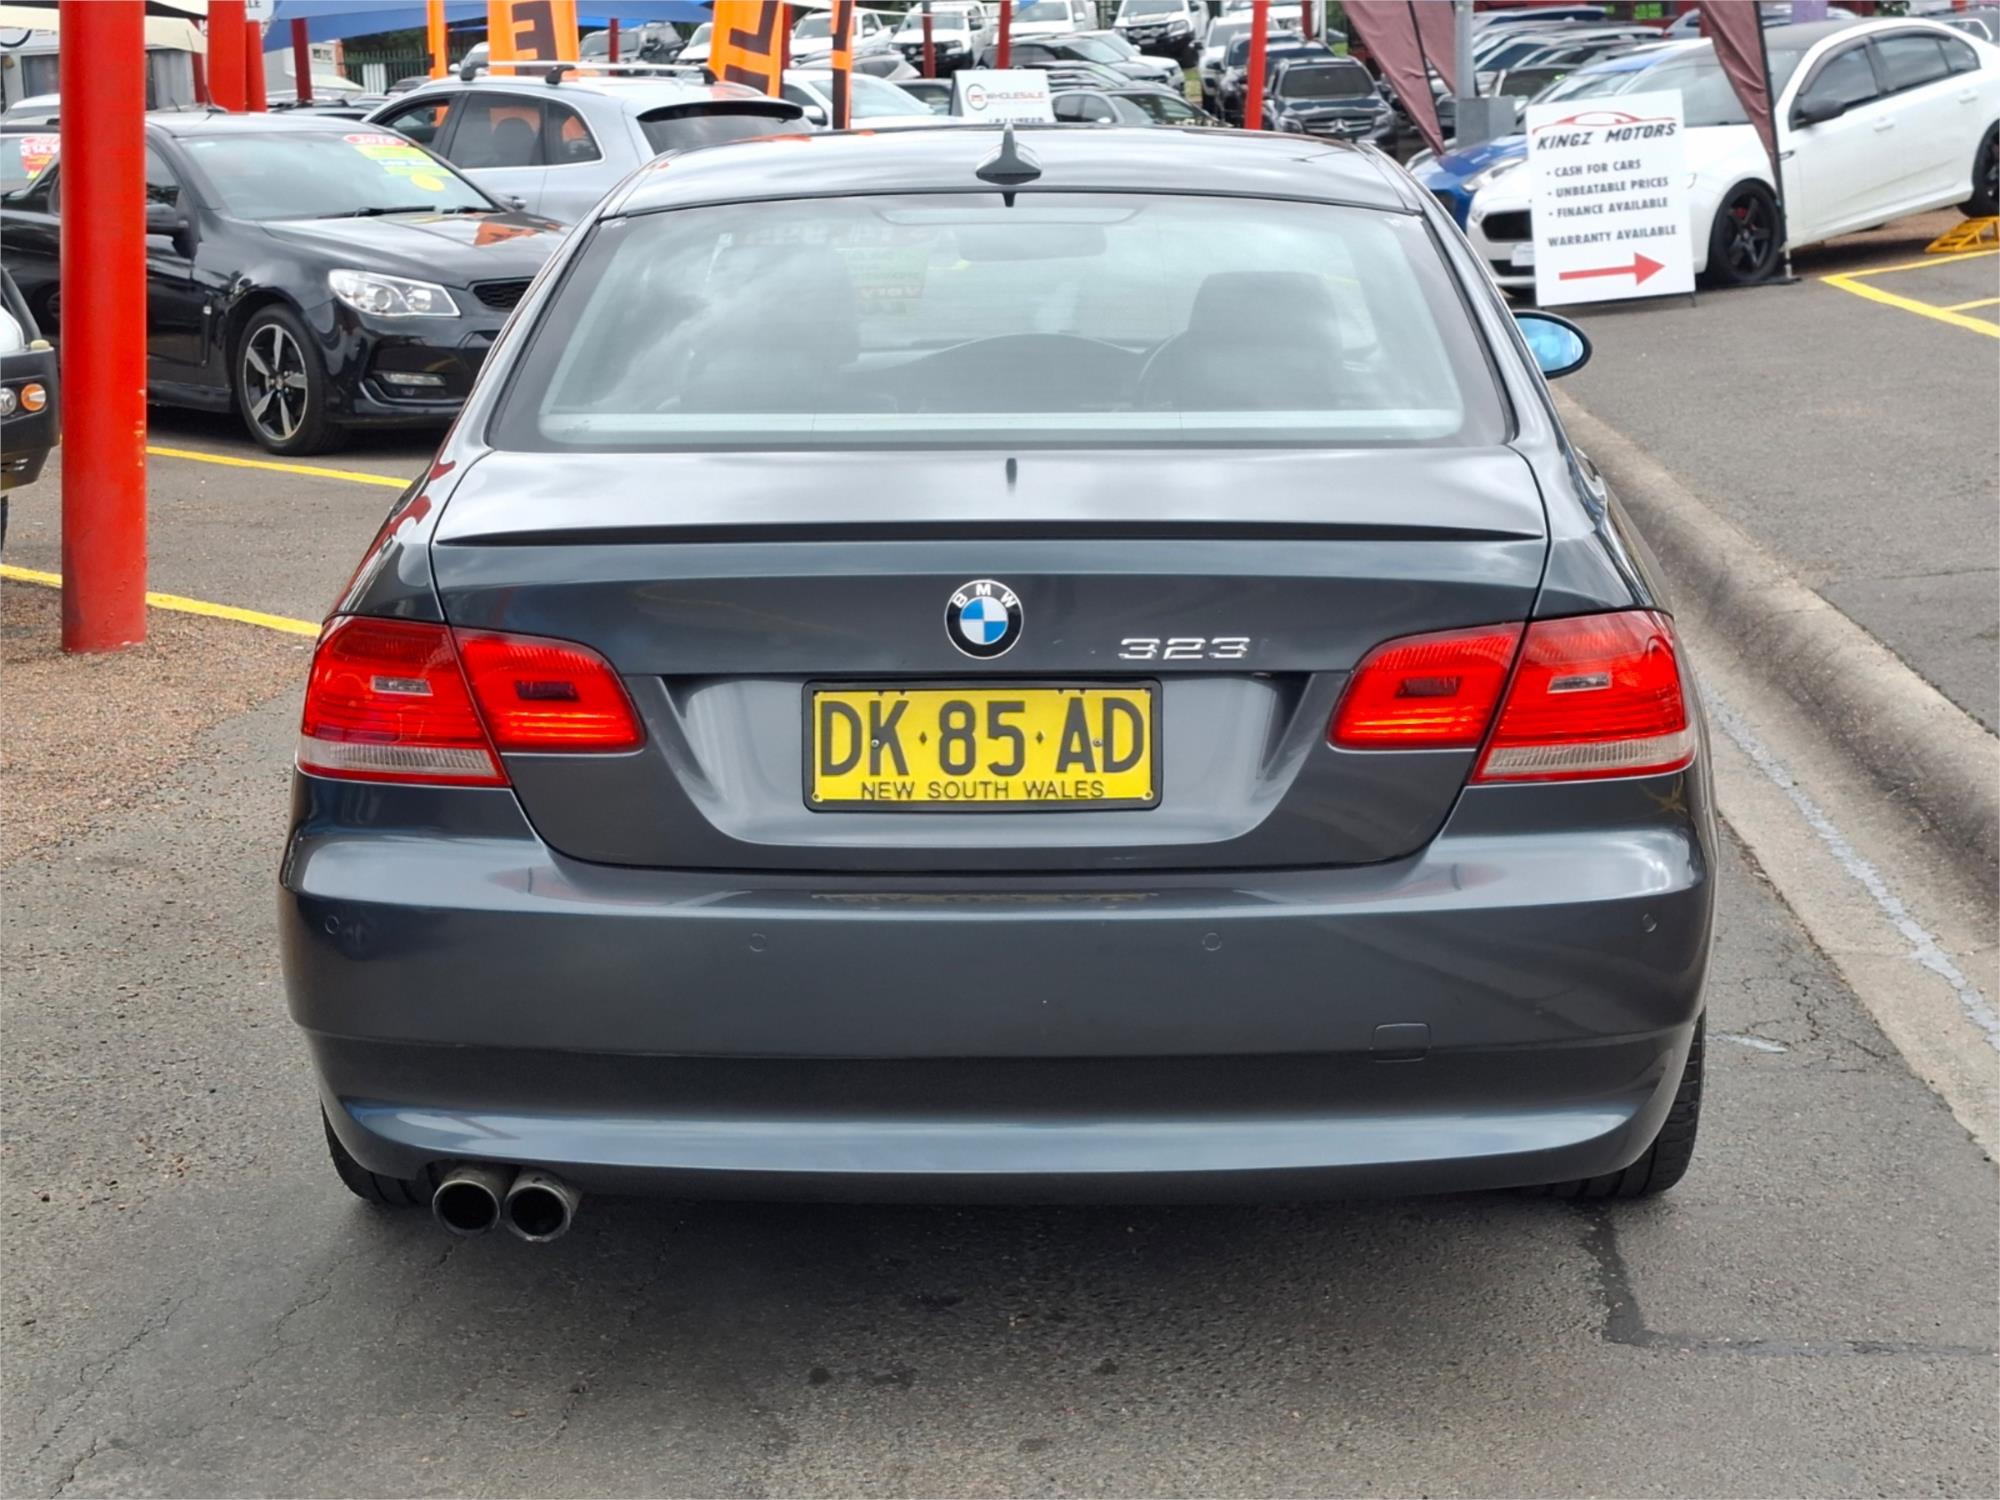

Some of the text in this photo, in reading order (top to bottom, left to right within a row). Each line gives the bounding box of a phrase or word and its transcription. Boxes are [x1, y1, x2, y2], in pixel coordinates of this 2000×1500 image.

[1536, 123, 1677, 150] KINGZ MOTORS
[1554, 159, 1641, 177] CASH FOR CARS
[1556, 176, 1669, 198] UNBEATABLE PRICES
[1557, 197, 1668, 218] FINANCE AVAILABLE
[1548, 224, 1677, 247] WARRANTY AVAILABLE
[952, 583, 1017, 608] BMW
[1118, 637, 1251, 660] 323
[820, 696, 1145, 777] DK 85 AD
[861, 780, 1105, 800] NEW SOUTH WALES
